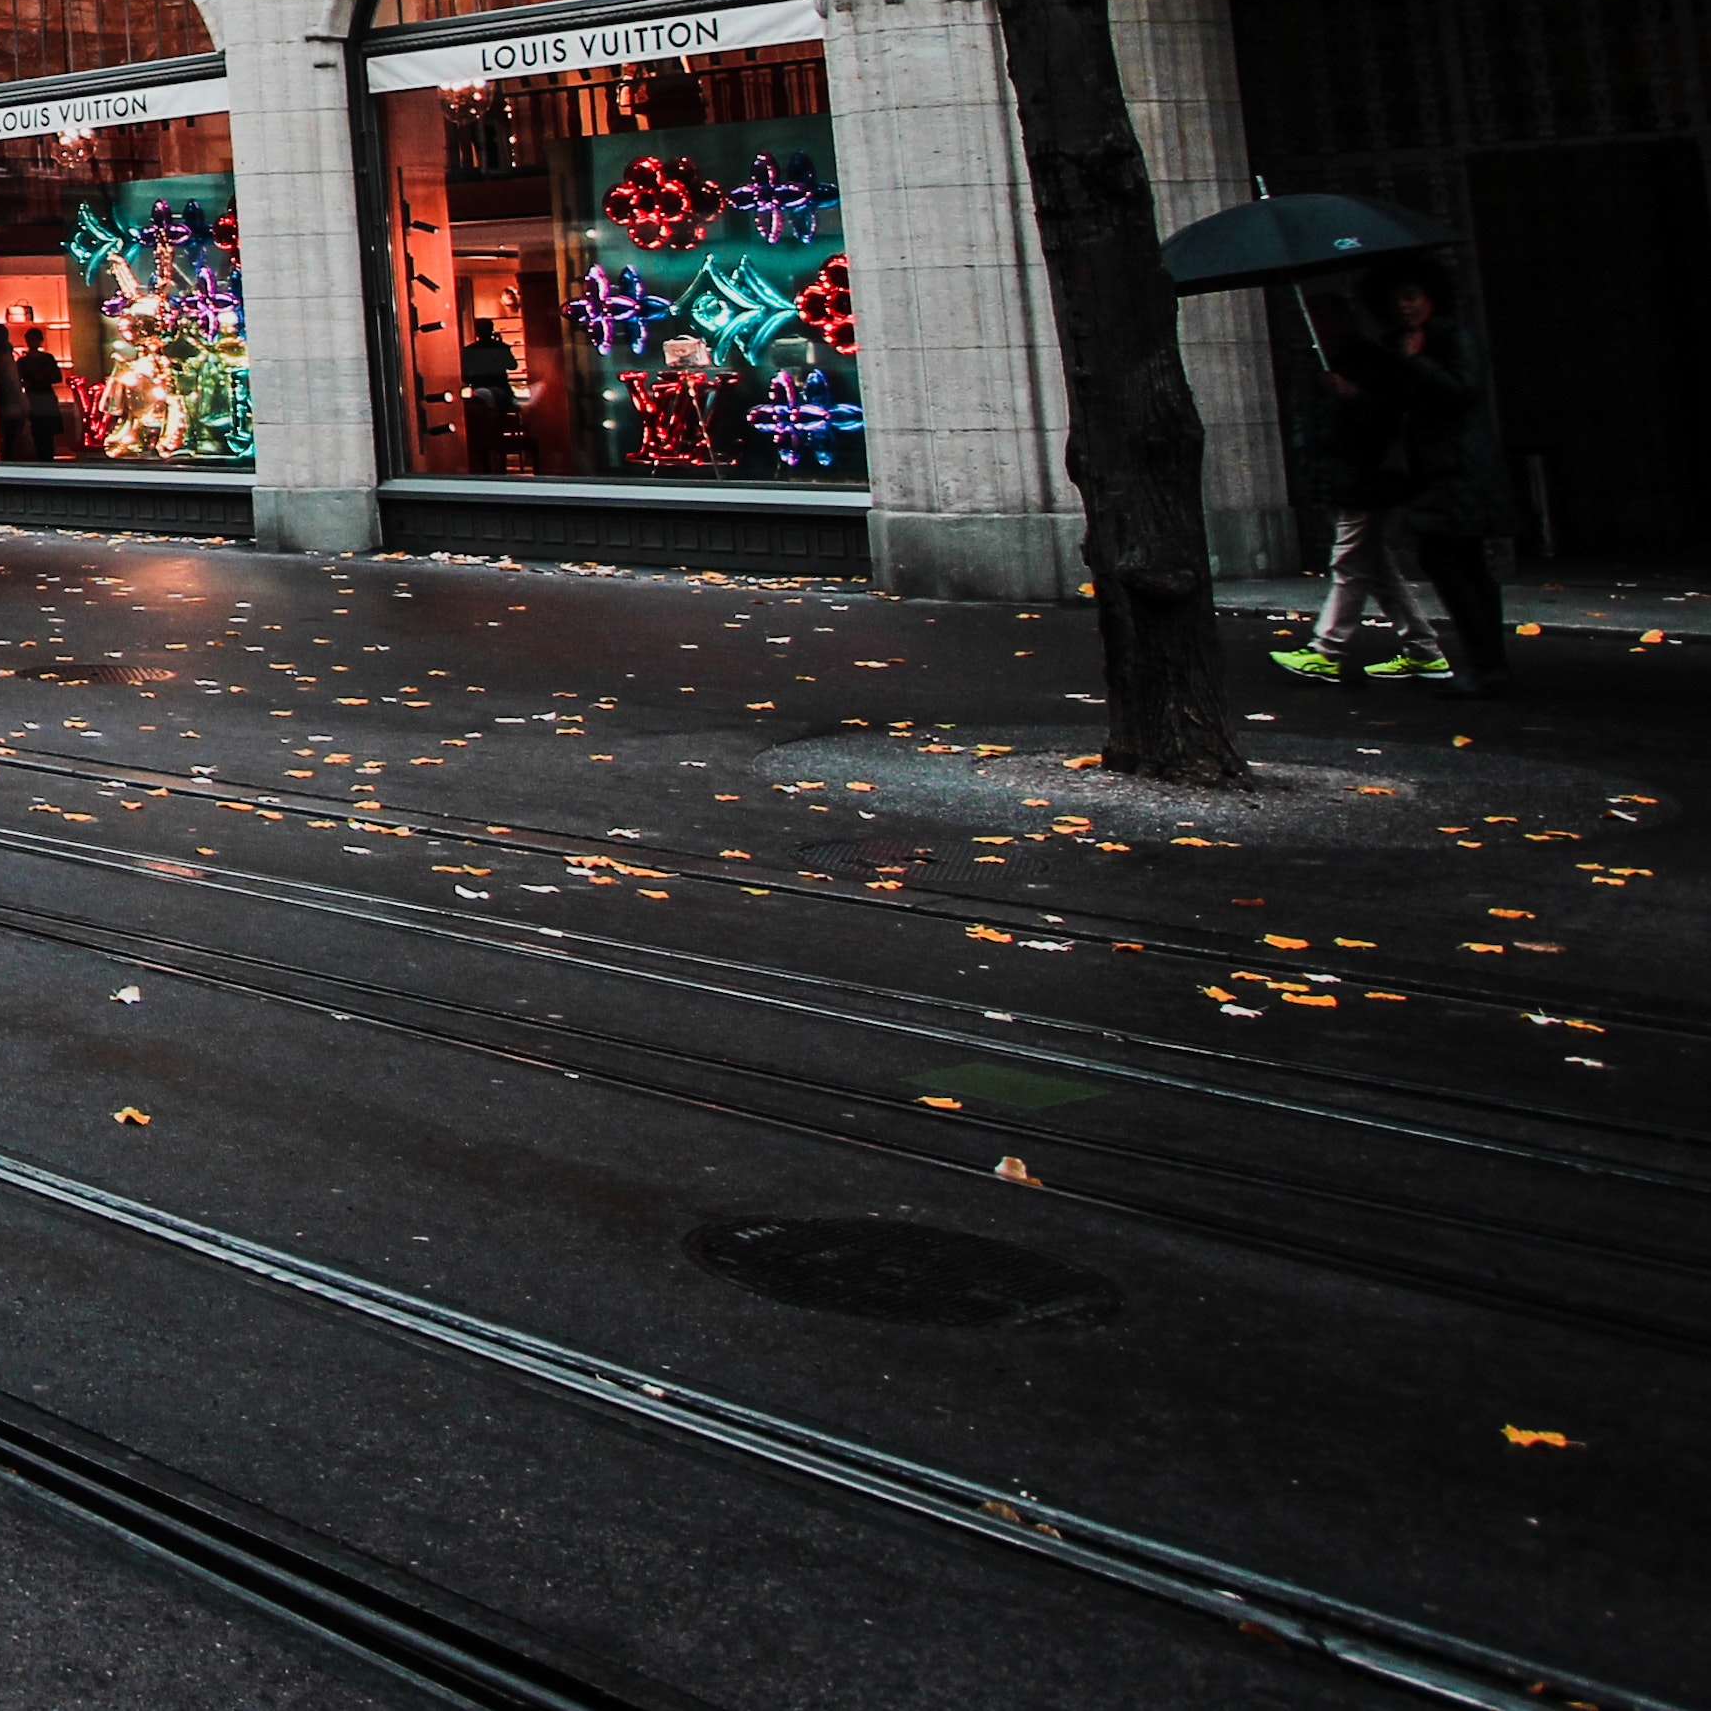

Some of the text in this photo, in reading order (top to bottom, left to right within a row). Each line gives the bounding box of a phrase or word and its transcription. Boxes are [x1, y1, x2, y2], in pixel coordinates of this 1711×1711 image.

[482, 18, 718, 71] LOUIS VUITTON
[59, 94, 147, 124] VUITTON
